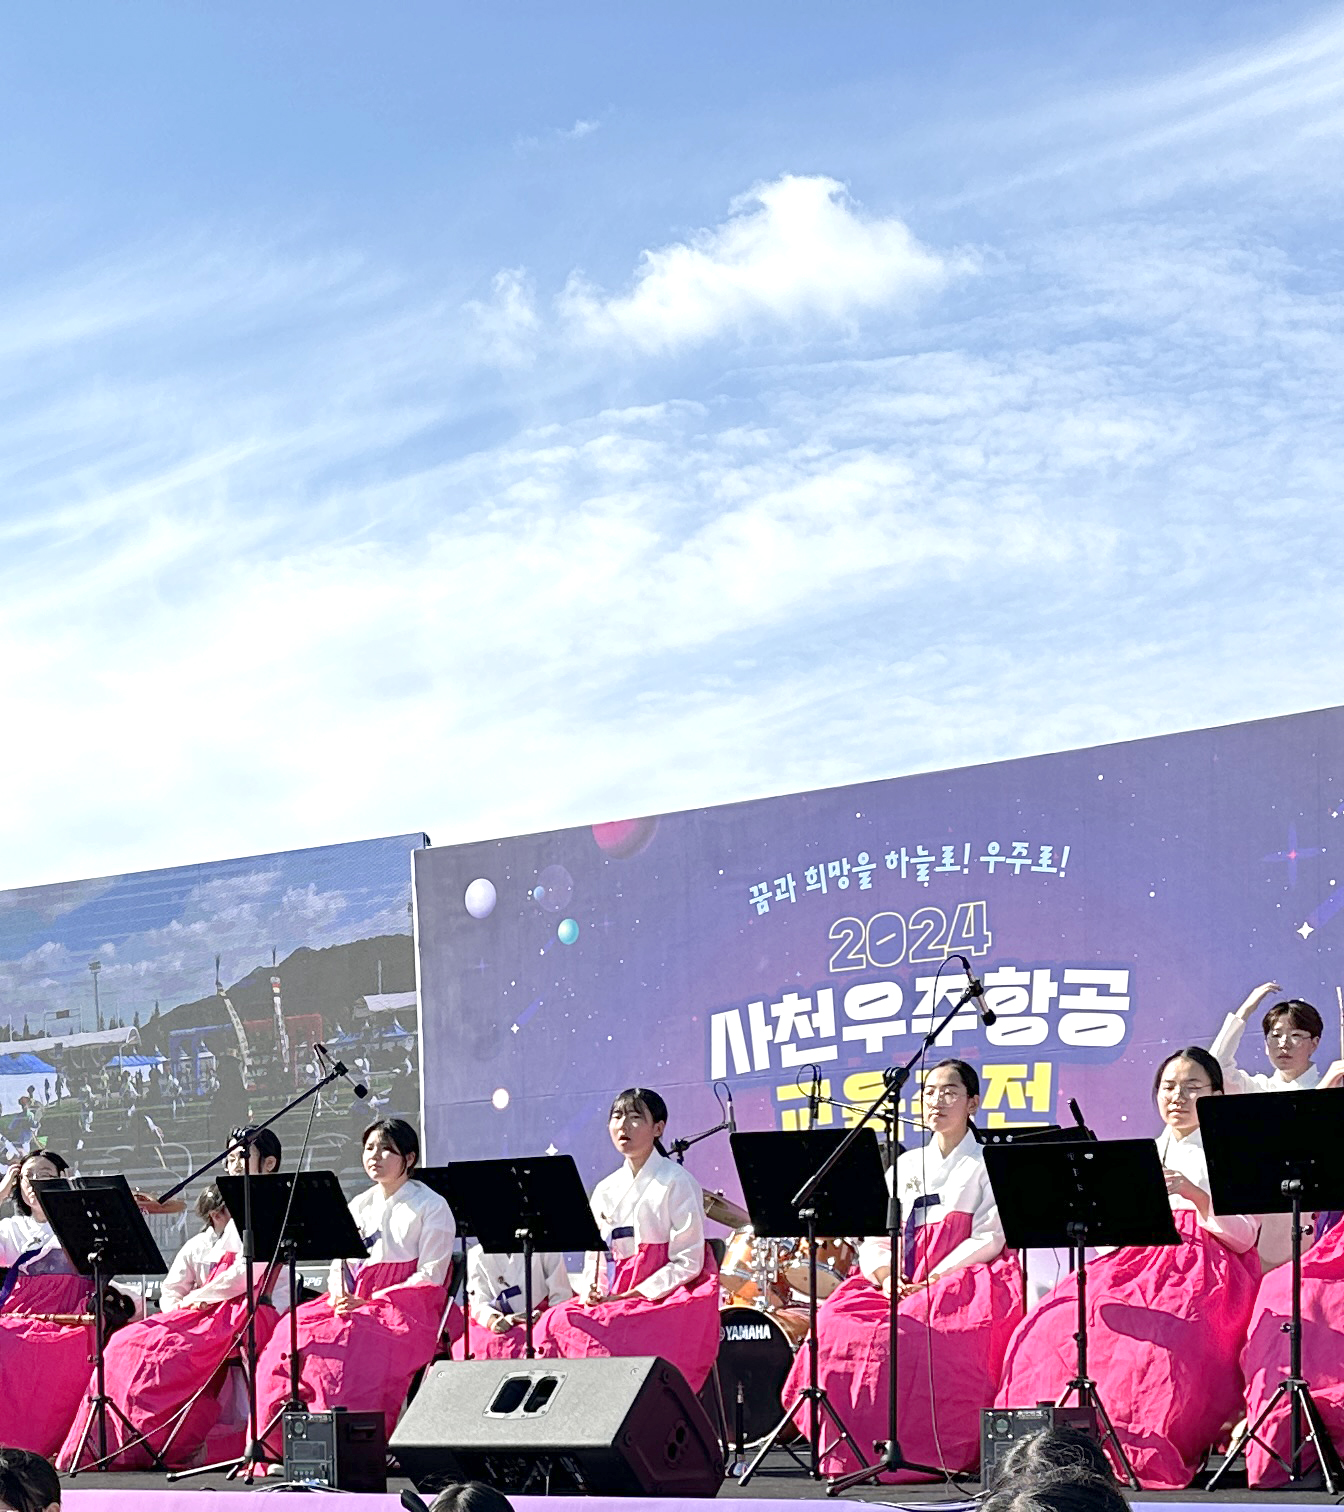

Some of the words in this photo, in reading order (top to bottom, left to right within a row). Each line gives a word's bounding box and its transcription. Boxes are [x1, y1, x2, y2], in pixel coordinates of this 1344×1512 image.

[749, 872, 797, 915] 꿈과
[804, 852, 877, 894] 희망을
[884, 843, 971, 882] 하늘로!
[980, 841, 1071, 878] 우주로!
[828, 900, 992, 972] 2024
[710, 966, 1131, 1081] 사천우주항공
[725, 1324, 772, 1341] YAMAHA
